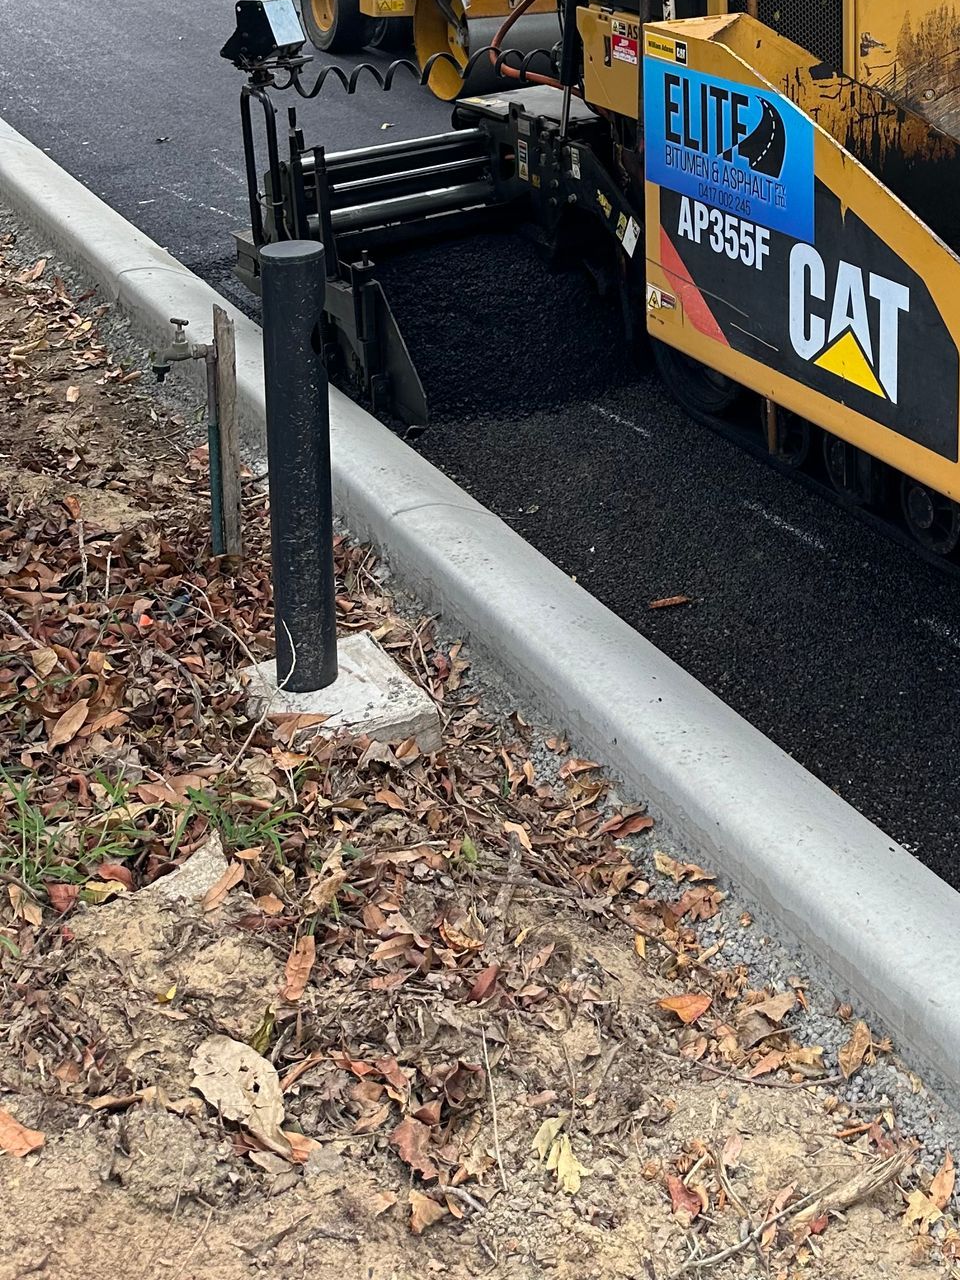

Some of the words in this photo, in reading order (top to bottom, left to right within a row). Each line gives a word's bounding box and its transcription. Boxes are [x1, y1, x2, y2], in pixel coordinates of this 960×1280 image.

[664, 72, 751, 162] ELITE
[665, 144, 710, 181] BITUMEN
[711, 161, 719, 183] &
[722, 164, 773, 203] ASPHALT
[698, 182, 717, 202] 0417
[718, 190, 734, 210] 002
[735, 196, 751, 217] 245
[677, 195, 770, 271] AP355F
[789, 242, 910, 405] CAT
